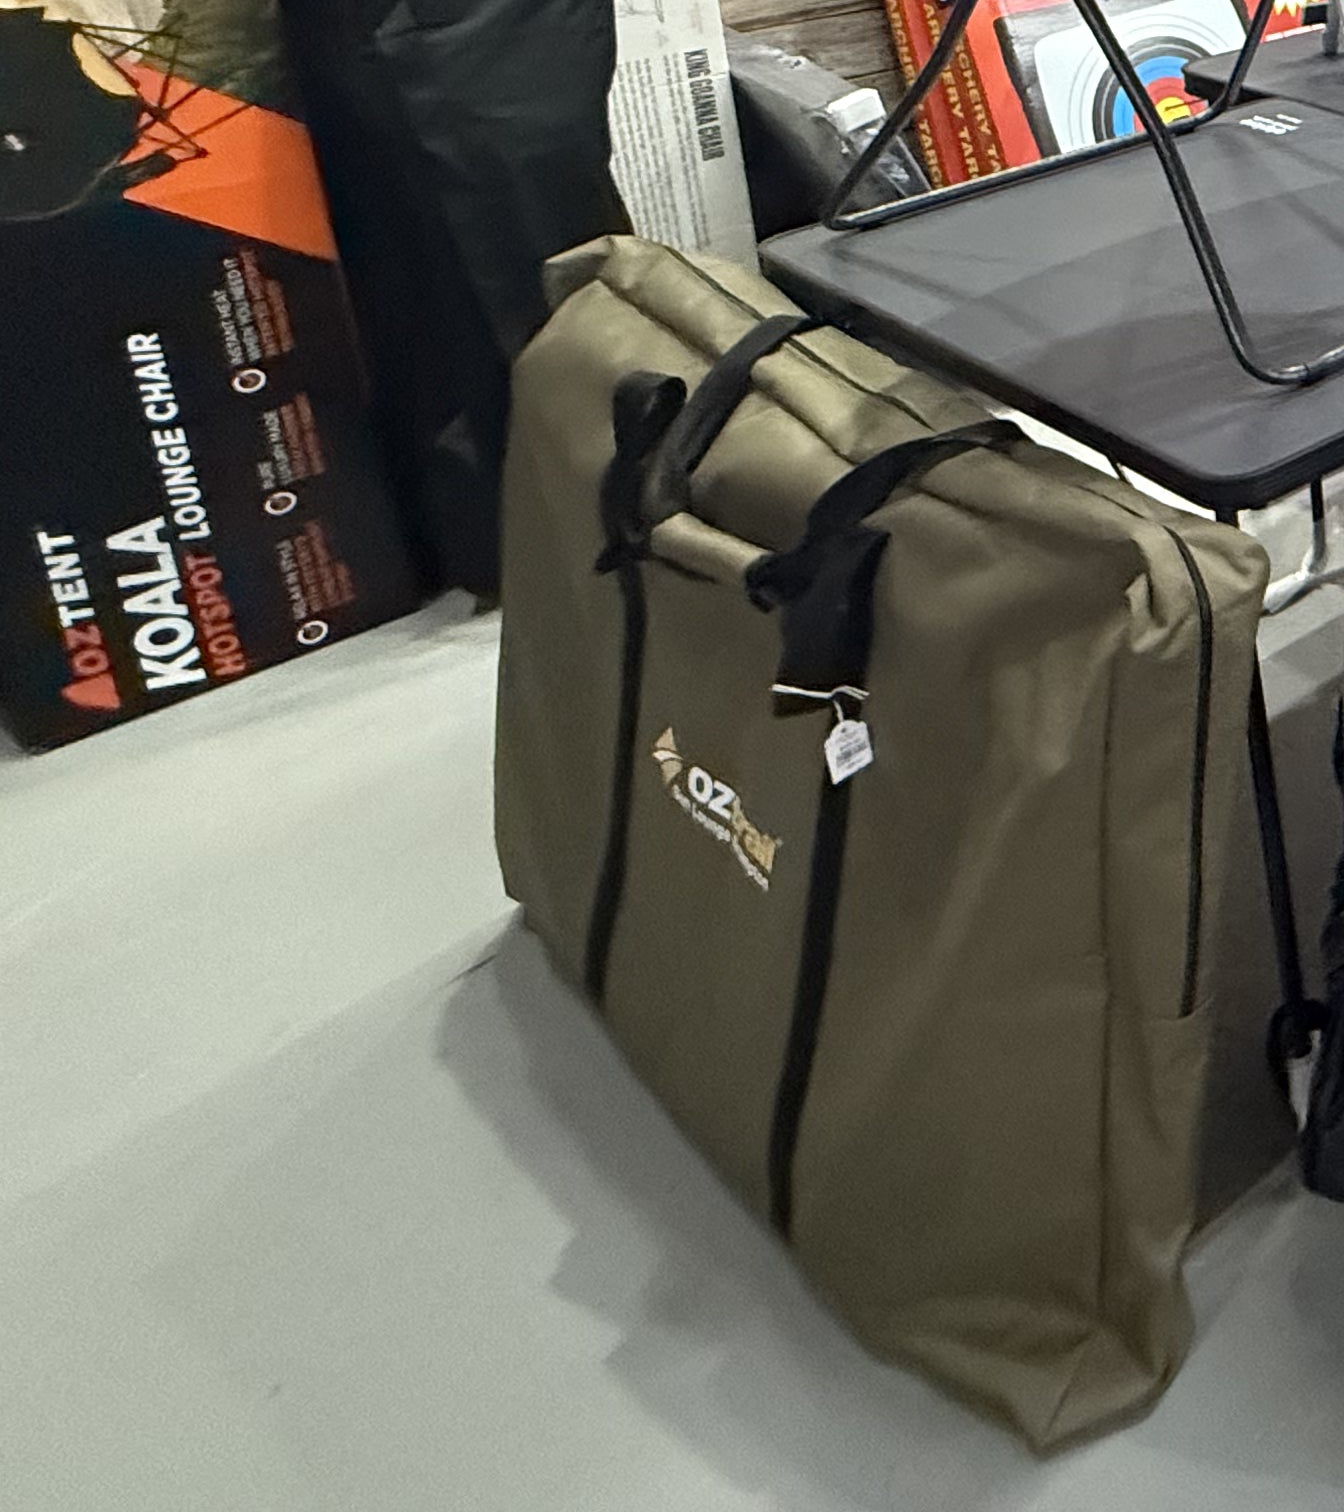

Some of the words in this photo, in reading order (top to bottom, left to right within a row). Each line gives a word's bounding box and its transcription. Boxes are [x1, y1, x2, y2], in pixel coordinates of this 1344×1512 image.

[684, 49, 711, 78] KING
[689, 78, 719, 127] GOANNA
[697, 125, 725, 162] CHAIR
[126, 331, 180, 424] CHAIR
[151, 426, 212, 541] LOUNGE
[105, 514, 208, 690] KOALA
[184, 550, 247, 677] HOTSPOT
